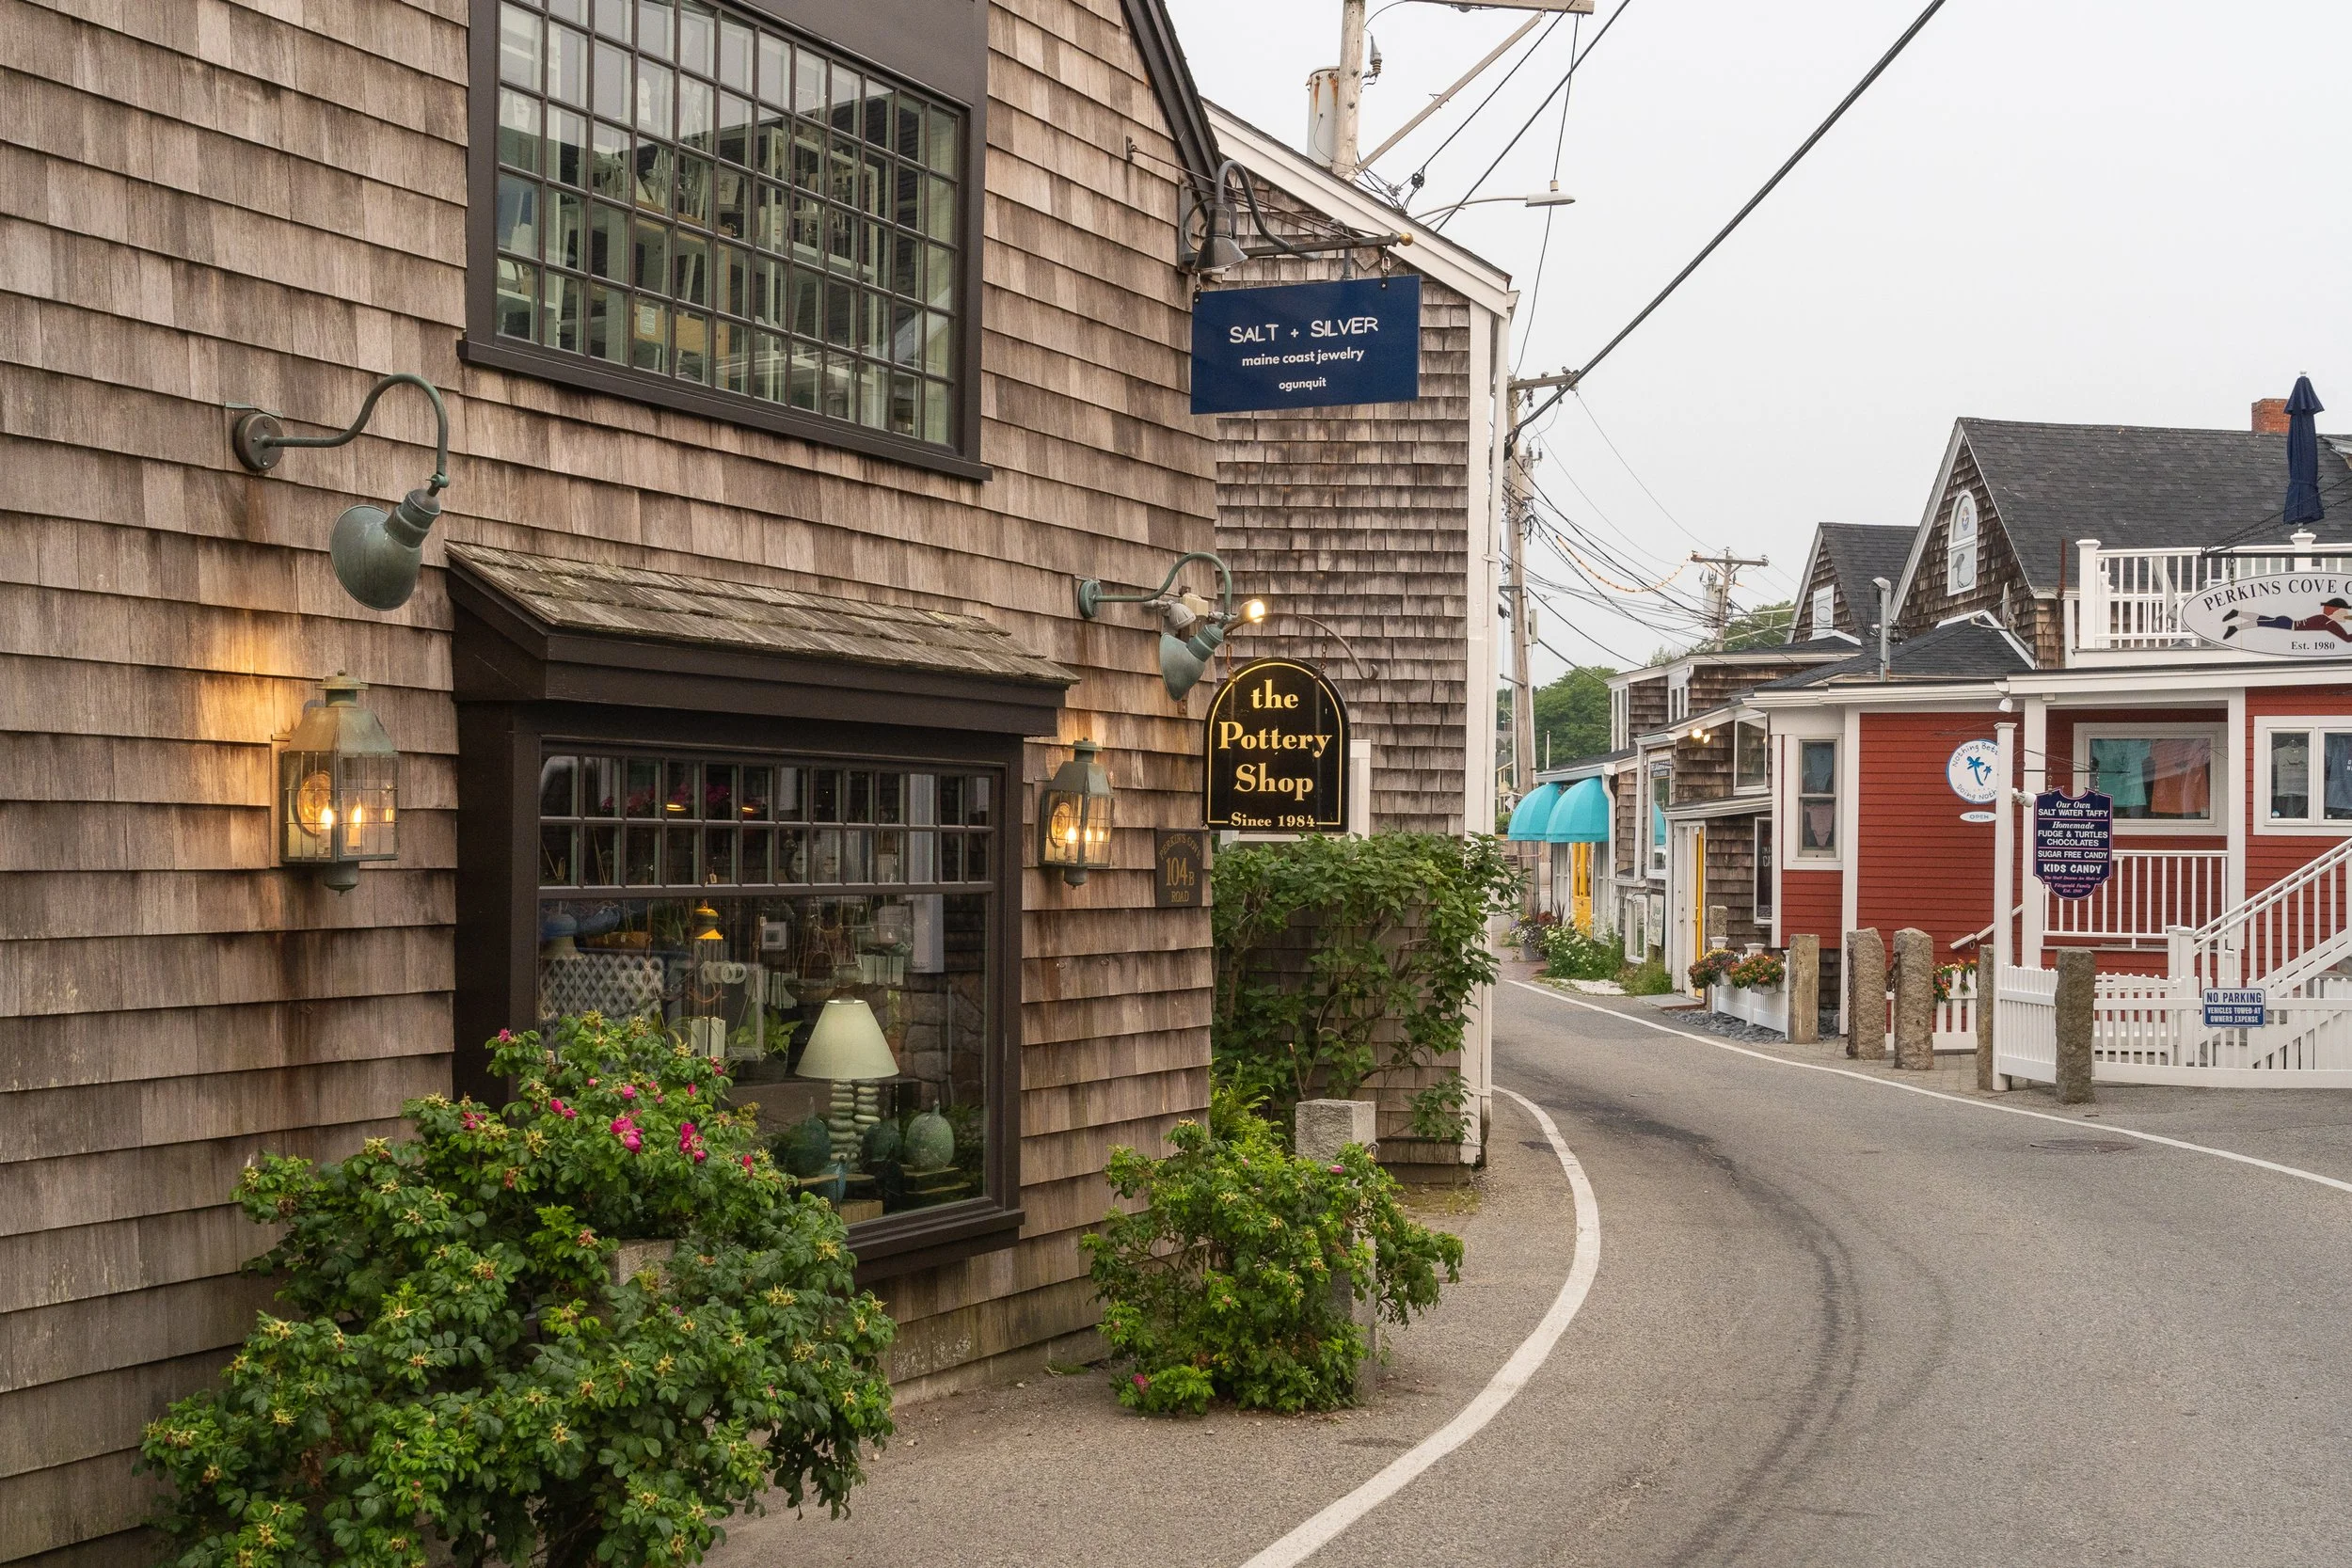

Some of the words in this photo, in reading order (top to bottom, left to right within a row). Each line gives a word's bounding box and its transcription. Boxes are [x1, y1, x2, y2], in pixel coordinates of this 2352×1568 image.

[1229, 324, 1279, 343] SALT
[1290, 327, 1299, 339] +
[1311, 317, 1379, 339] SILVER
[1242, 354, 1279, 367] maine
[1282, 351, 1315, 364] coast
[1316, 347, 1365, 365] jewelry
[1279, 377, 1327, 392] ogunquit
[2203, 580, 2281, 611] PERKINS
[2288, 578, 2337, 594] COVE
[2291, 641, 2310, 650] Est.
[2314, 641, 2335, 650] 1980
[1250, 679, 1299, 709] the
[1218, 721, 1333, 758] Pottery
[1952, 744, 1979, 768] Nothing
[1233, 762, 1314, 801] Shop
[1957, 784, 1977, 800] Doing
[2074, 800, 2090, 809] Own
[2038, 808, 2057, 816] SALT
[2086, 809, 2108, 817] TAFFY
[1230, 811, 1272, 828] Since
[1277, 815, 1316, 828] 1984
[2052, 821, 2095, 830] Homemade
[2074, 831, 2108, 839] TURTLES
[2046, 838, 2100, 847] CHOCOLATES
[2064, 850, 2082, 859] FREE
[2043, 863, 2067, 873] KIDS
[2070, 864, 2102, 874] CANDY
[1171, 891, 1189, 903] ROAD
[2207, 992, 2218, 1003] NO
[2223, 992, 2262, 1003] PARKING
